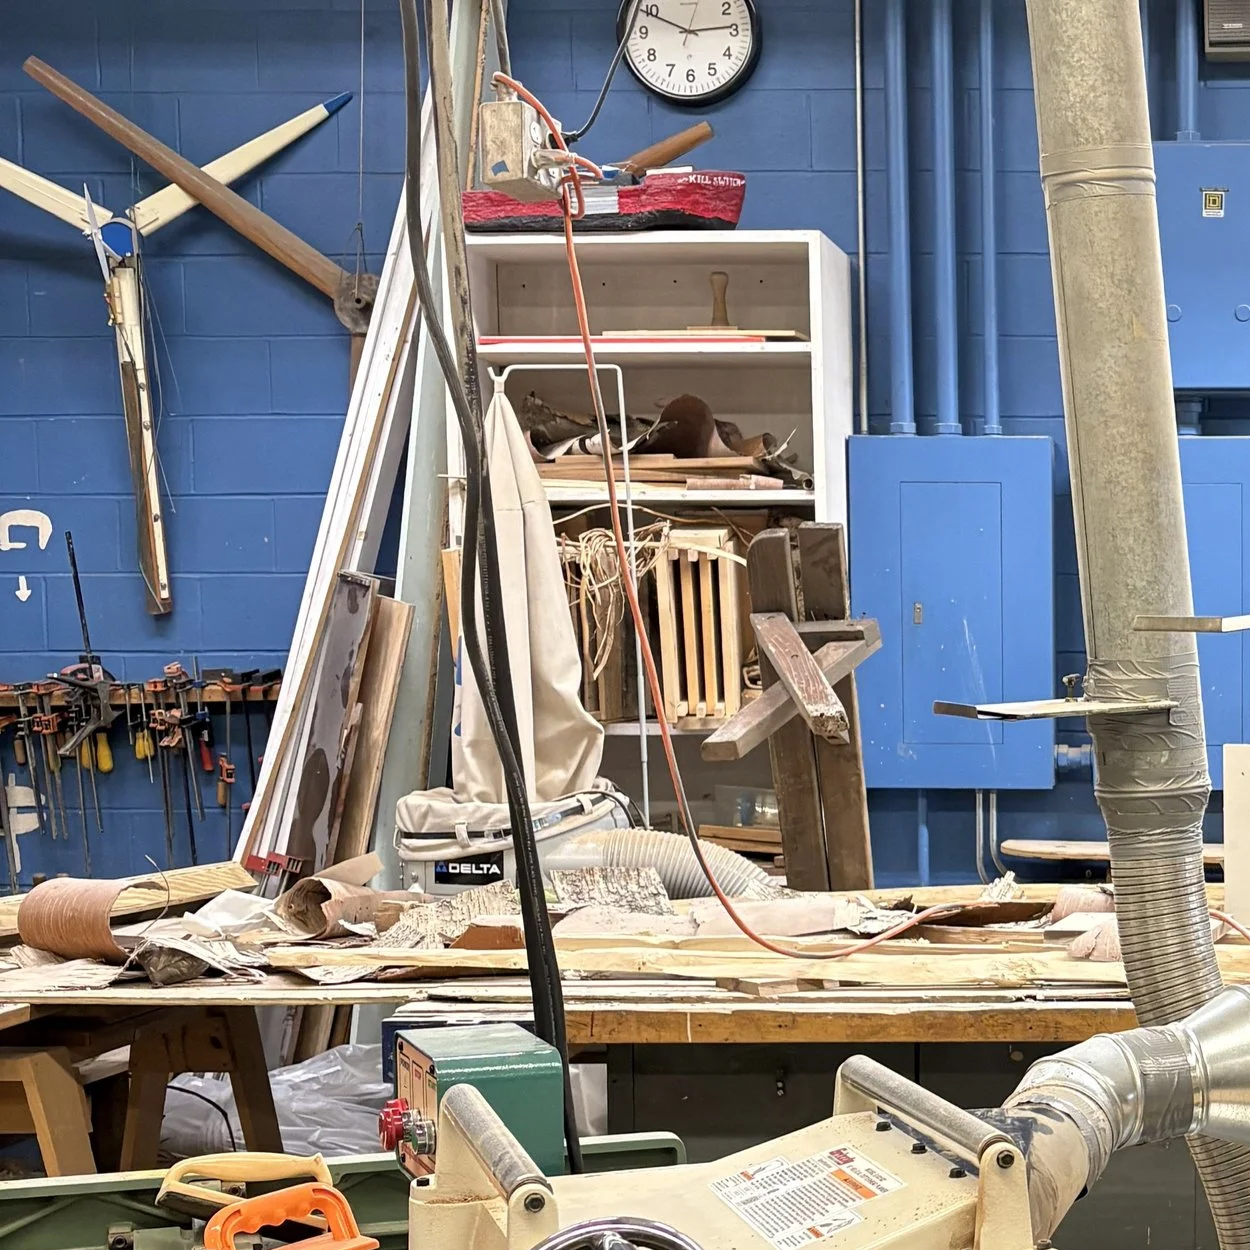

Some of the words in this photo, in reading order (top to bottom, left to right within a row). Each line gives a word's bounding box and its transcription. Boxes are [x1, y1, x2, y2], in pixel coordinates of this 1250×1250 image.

[722, 2, 731, 15] 2
[639, 26, 648, 39] 9
[729, 23, 739, 37] 3
[647, 48, 656, 62] 8
[723, 46, 732, 60] 4
[666, 64, 676, 77] 7
[686, 69, 696, 83] 6
[707, 63, 717, 76] 5
[689, 174, 711, 184] KILL
[448, 863, 501, 875] DELTA
